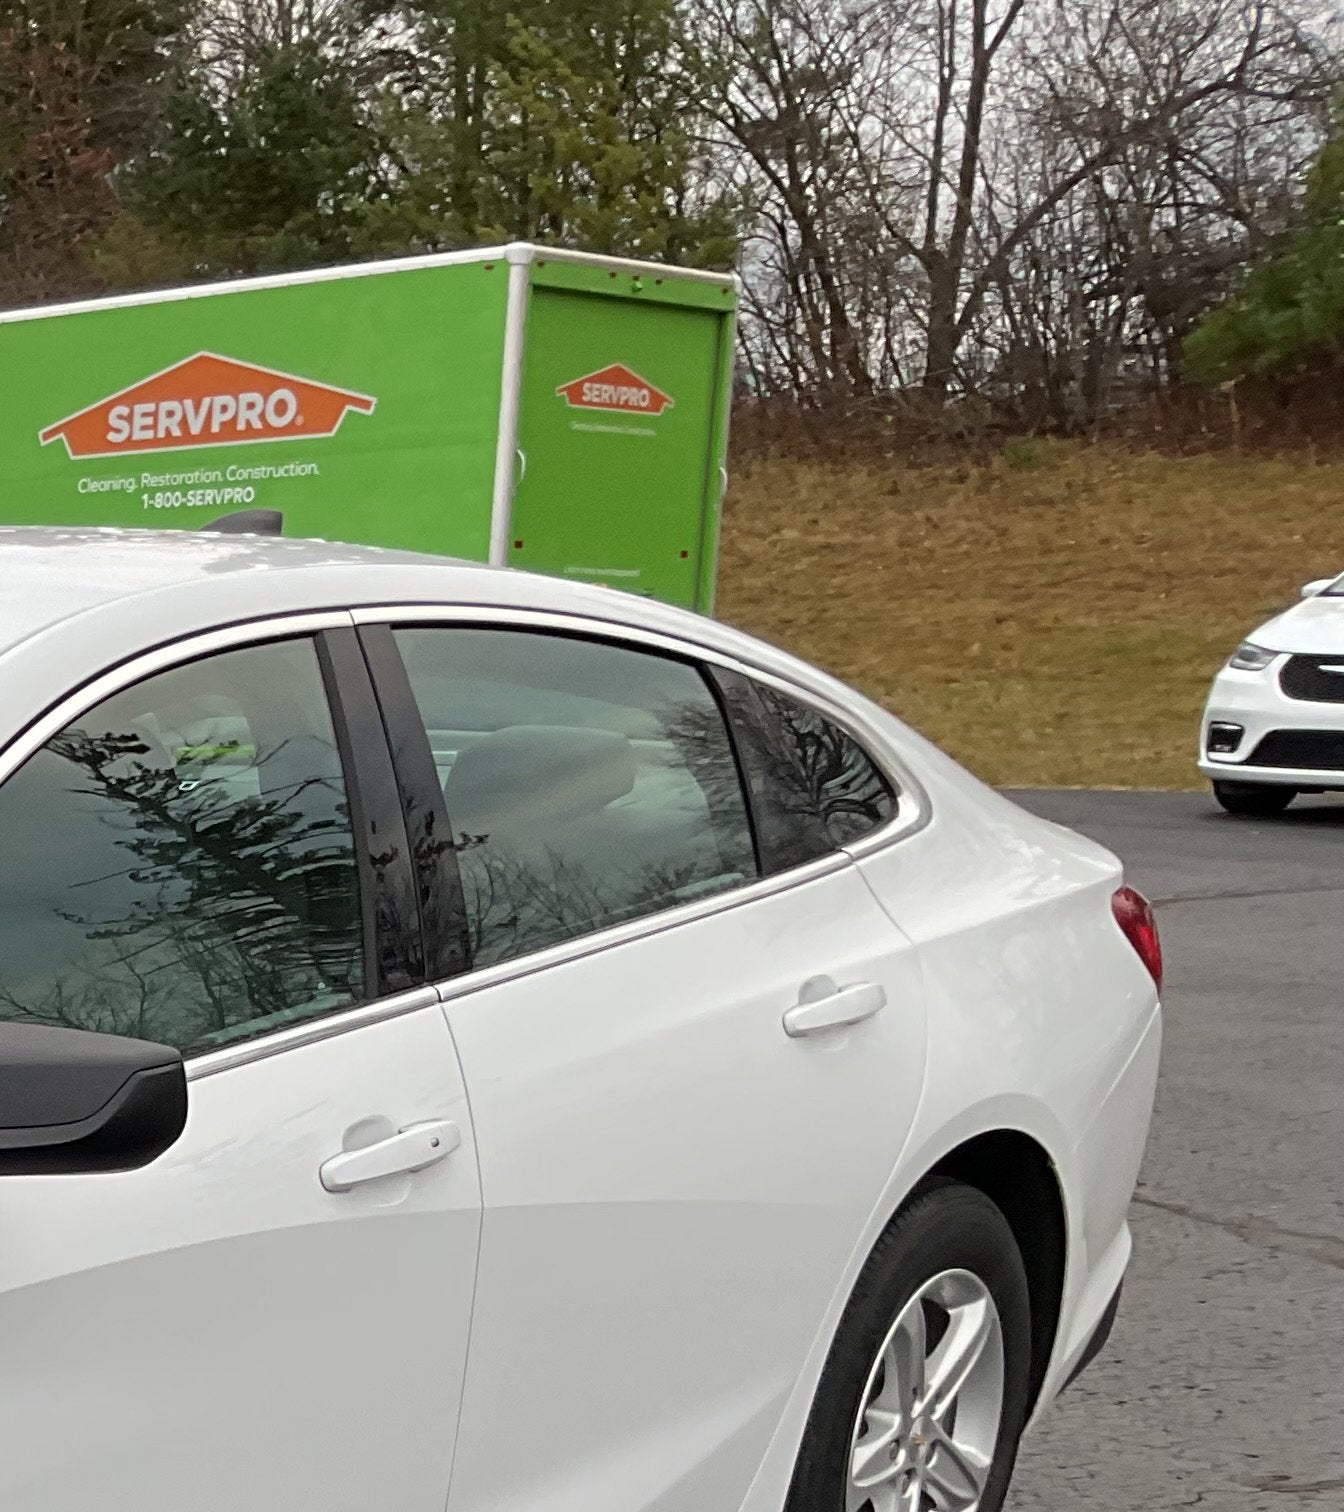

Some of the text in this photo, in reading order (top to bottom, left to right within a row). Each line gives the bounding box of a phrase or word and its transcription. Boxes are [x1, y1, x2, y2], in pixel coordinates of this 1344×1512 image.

[582, 382, 650, 407] SERVPRO
[106, 387, 298, 443] SERVPRO
[140, 468, 223, 488] Restoration.
[226, 462, 320, 482] Construction.
[140, 486, 255, 509] 1-800-SERVPRO
